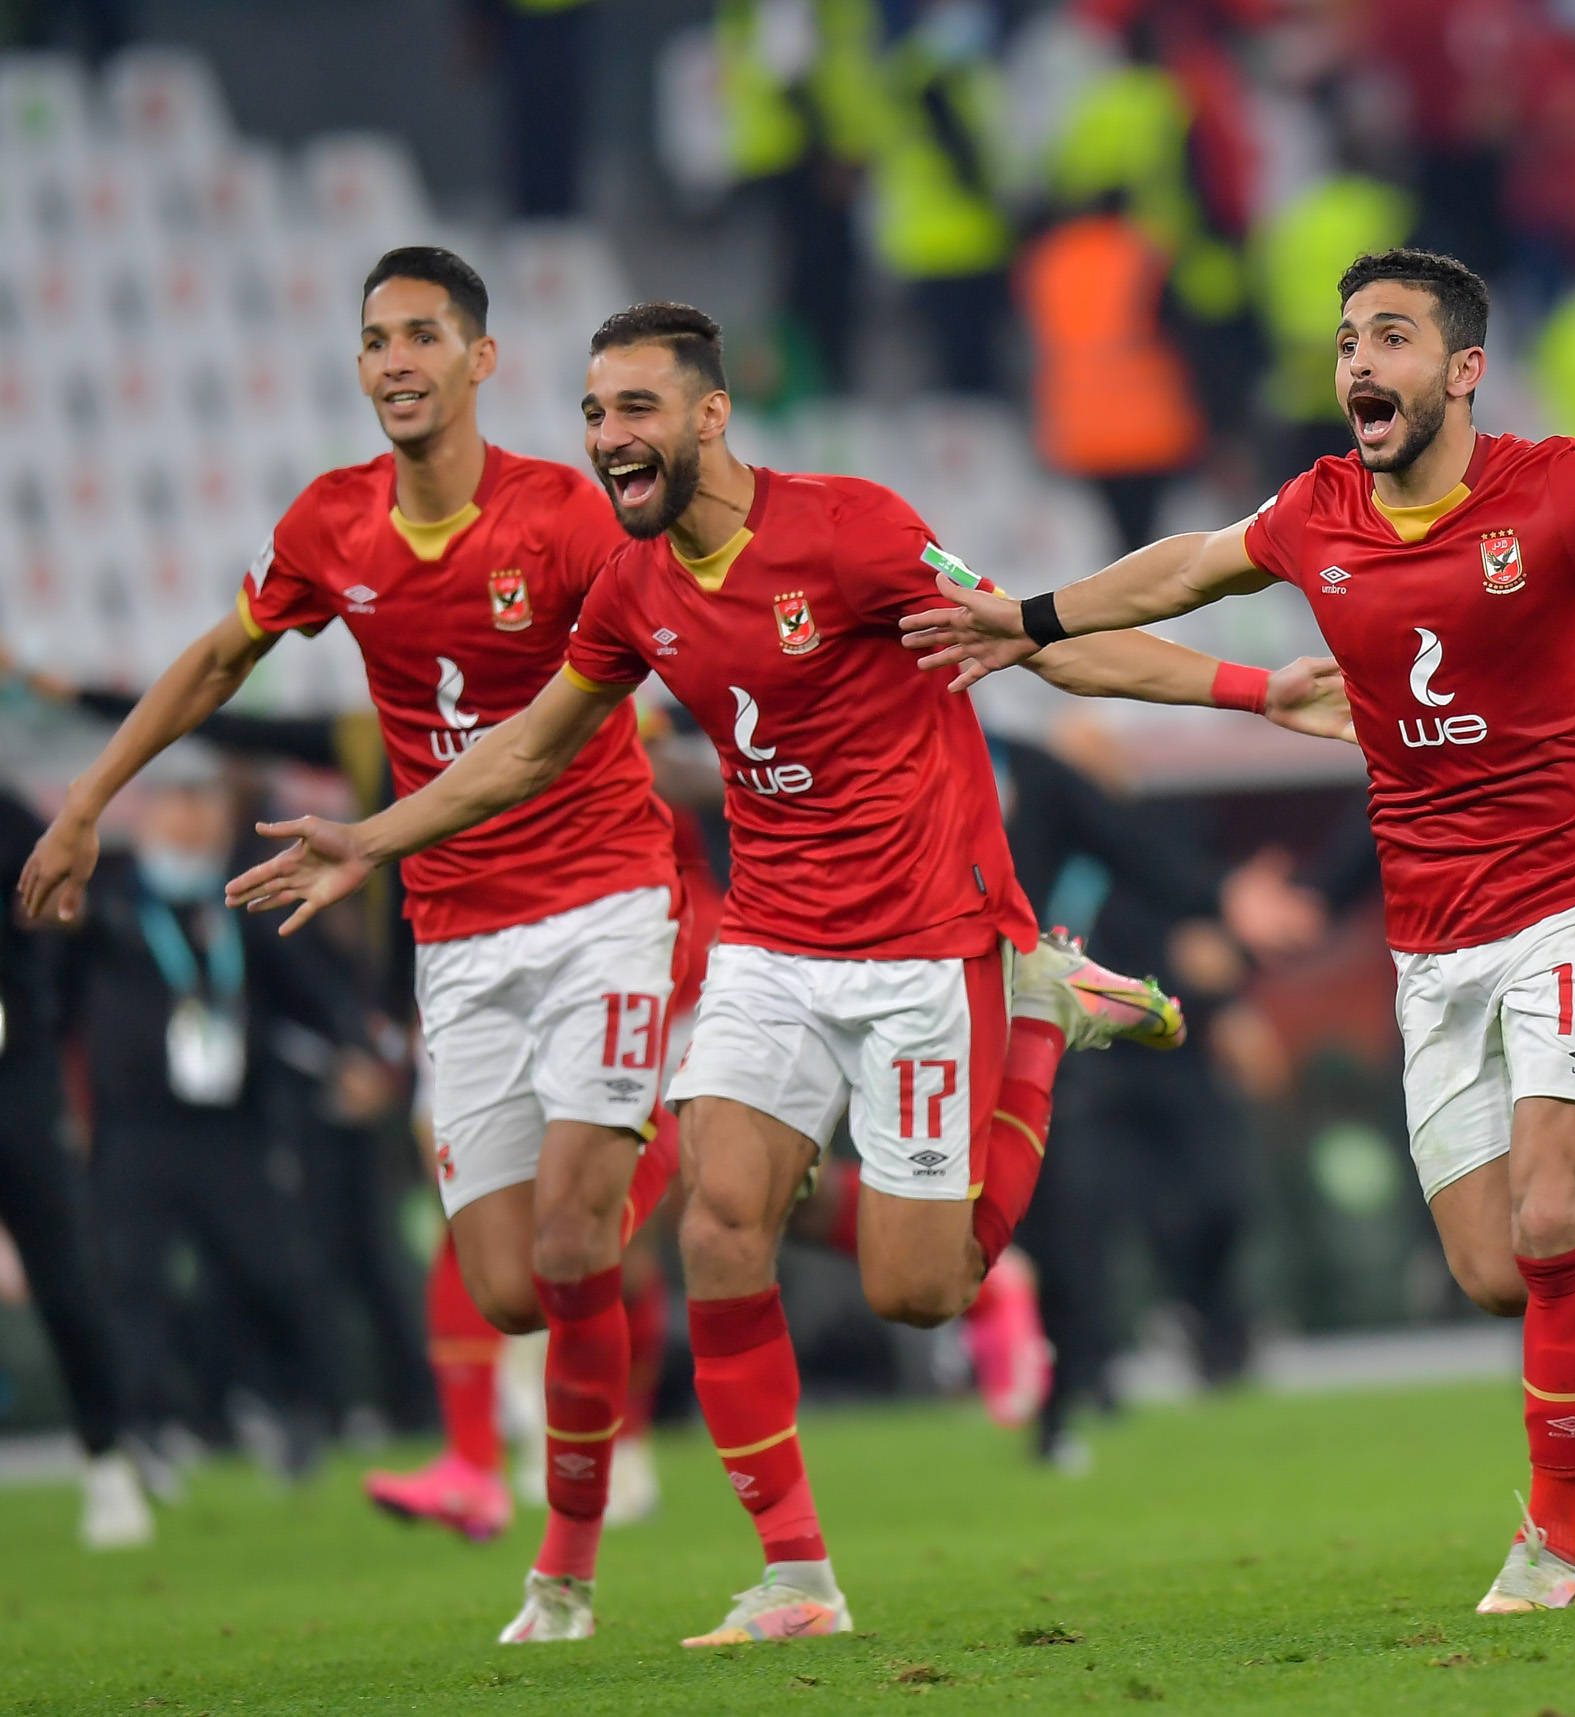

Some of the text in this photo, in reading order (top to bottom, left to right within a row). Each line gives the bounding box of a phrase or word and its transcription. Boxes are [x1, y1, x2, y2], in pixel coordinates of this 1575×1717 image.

[1321, 585, 1347, 594] umbro
[430, 726, 493, 762] w
[1398, 714, 1488, 748] we
[737, 764, 814, 794] we
[601, 992, 660, 1070] 13
[892, 1060, 957, 1139] 17
